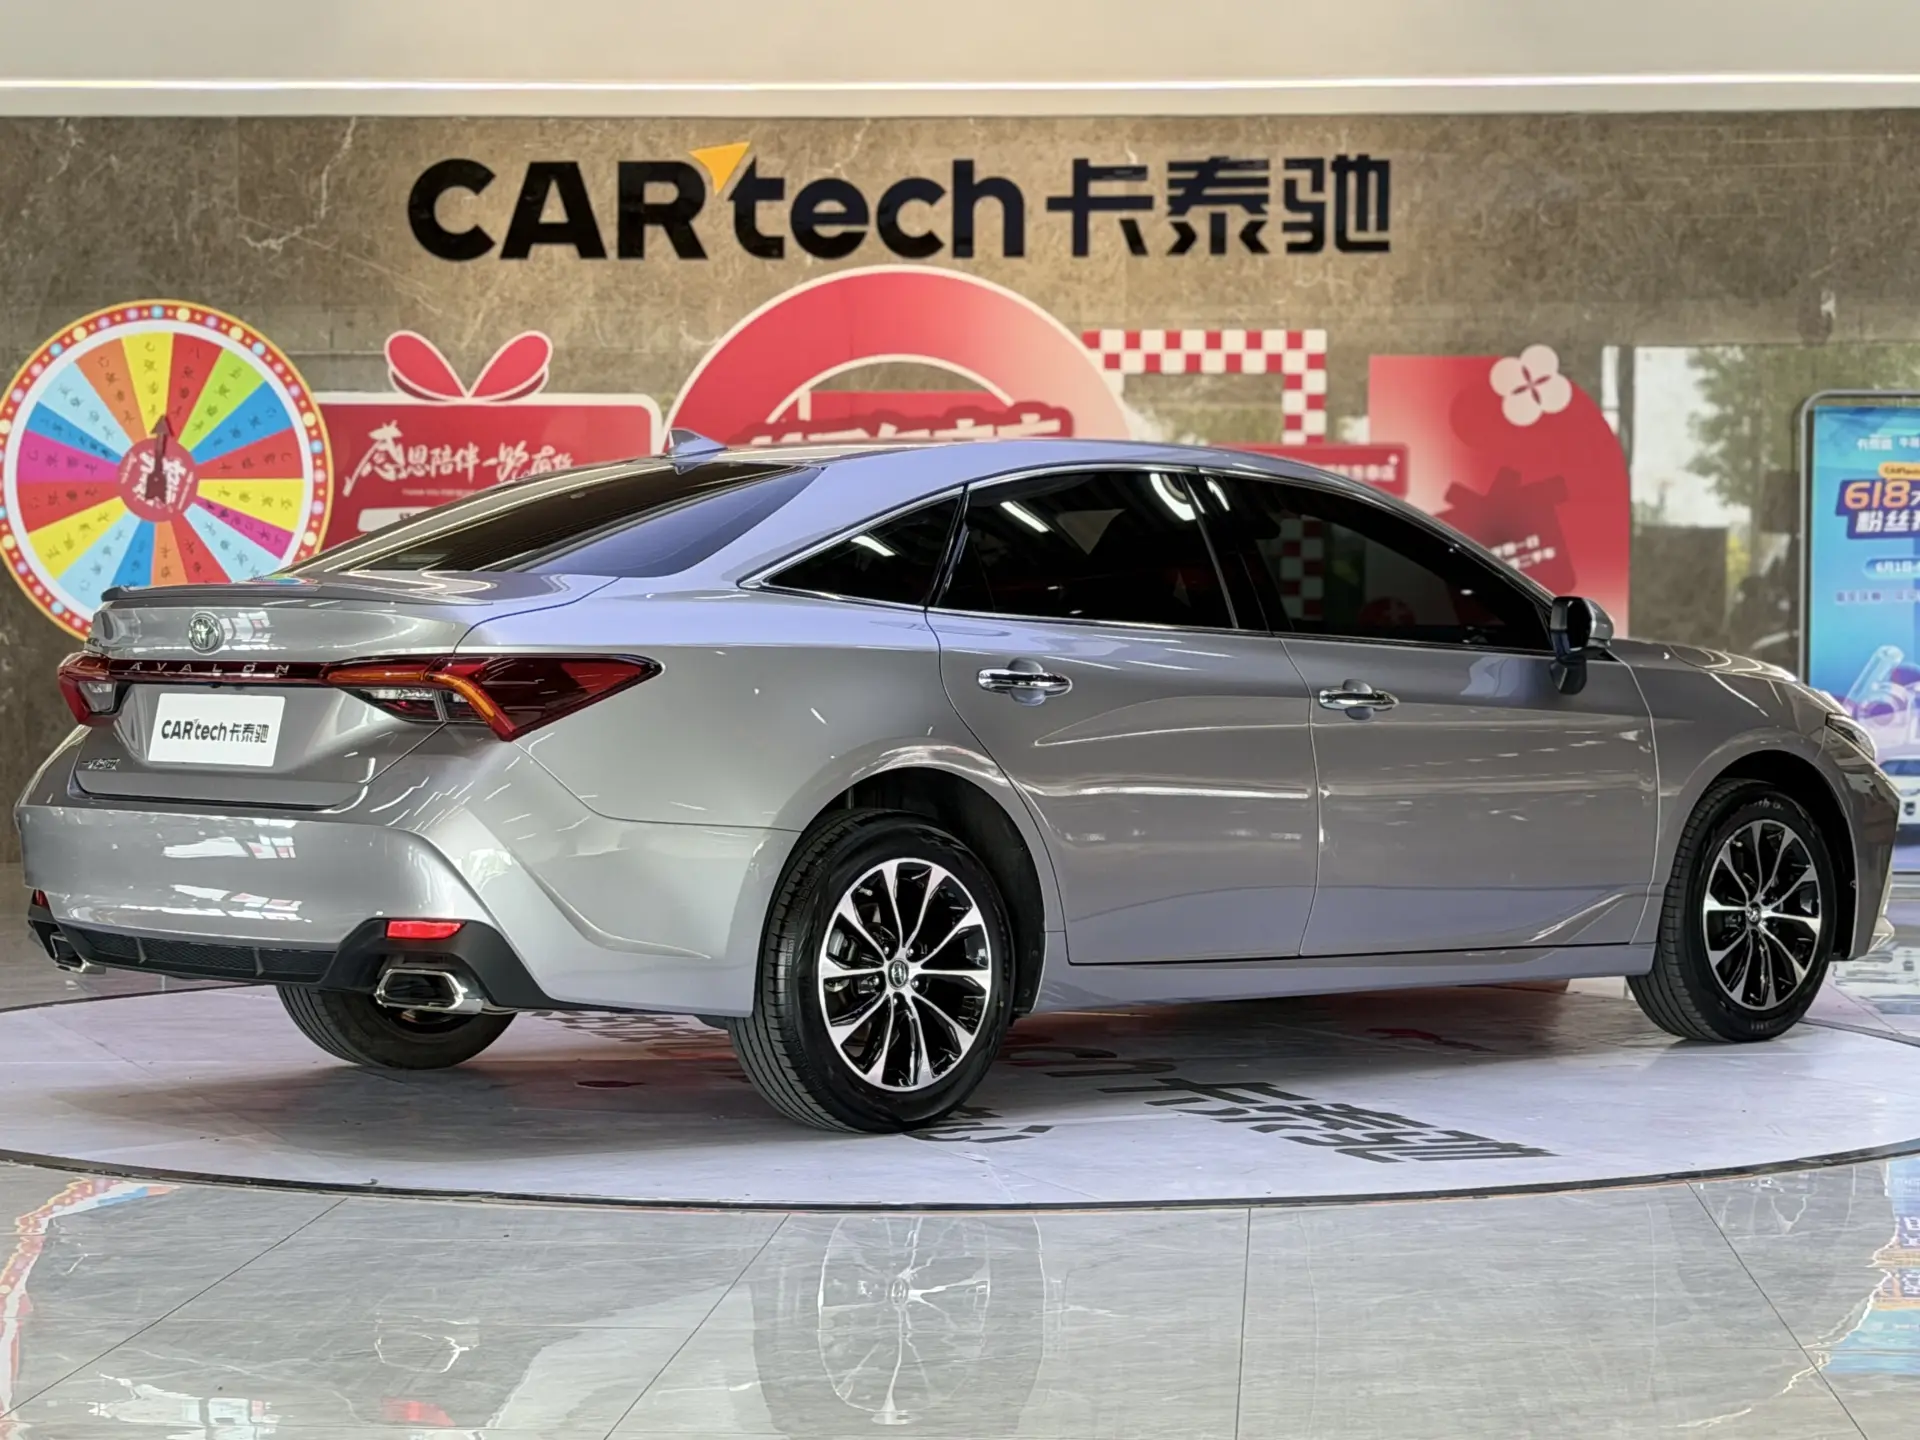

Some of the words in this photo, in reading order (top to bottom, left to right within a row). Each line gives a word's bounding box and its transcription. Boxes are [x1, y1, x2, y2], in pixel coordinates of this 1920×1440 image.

[407, 158, 1025, 261] CARtech
[1047, 154, 1392, 257] 卡泰驰
[129, 661, 291, 675] AVALON
